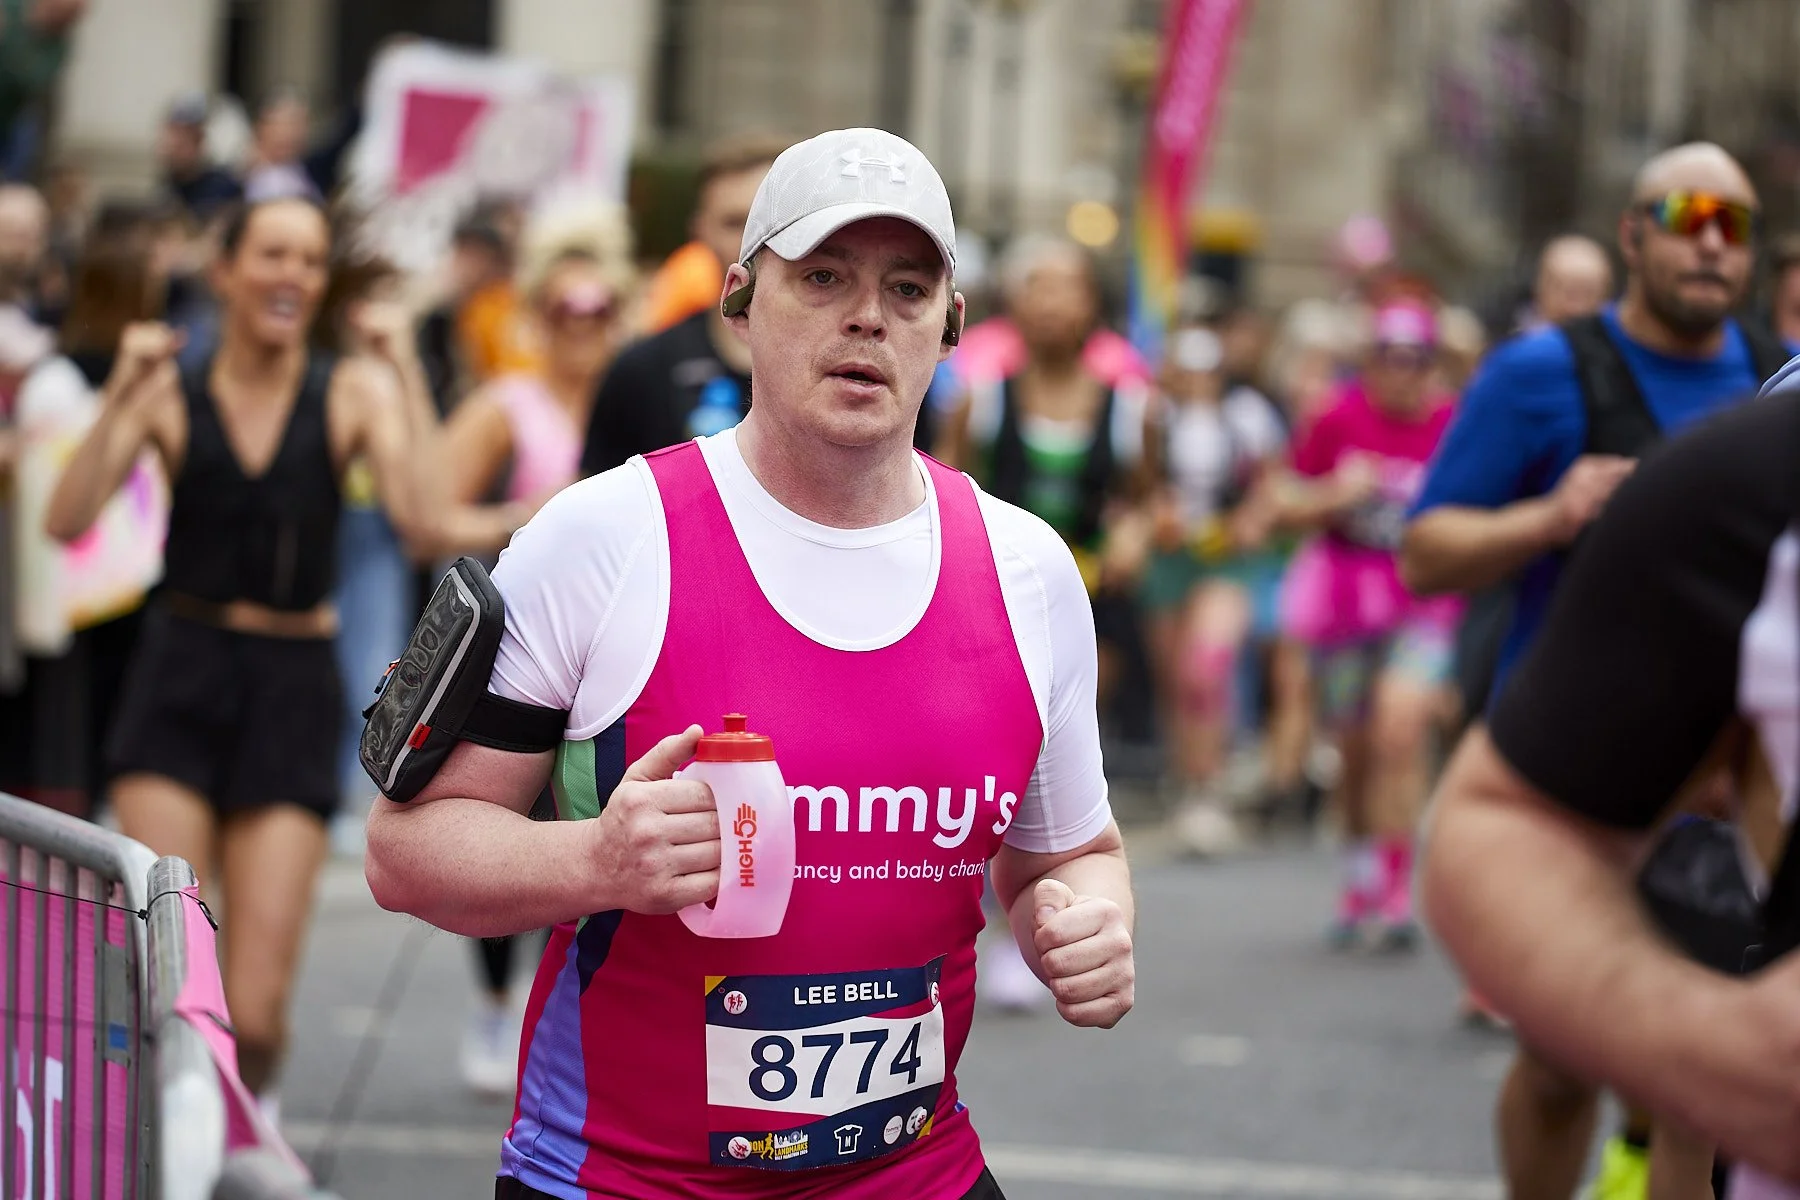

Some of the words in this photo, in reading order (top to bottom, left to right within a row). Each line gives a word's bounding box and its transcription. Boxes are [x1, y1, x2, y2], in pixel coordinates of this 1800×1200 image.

[785, 775, 1018, 849] mmy's
[733, 803, 757, 887] HIGH5
[792, 864, 842, 884] ancy
[848, 859, 889, 880] and
[896, 859, 945, 882] baby
[949, 857, 985, 877] charit
[794, 985, 837, 1005] LEE
[844, 980, 898, 1002] BELL
[748, 1021, 922, 1102] 8774
[750, 1140, 764, 1152] ON
[775, 1142, 808, 1156] LANDMARKS
